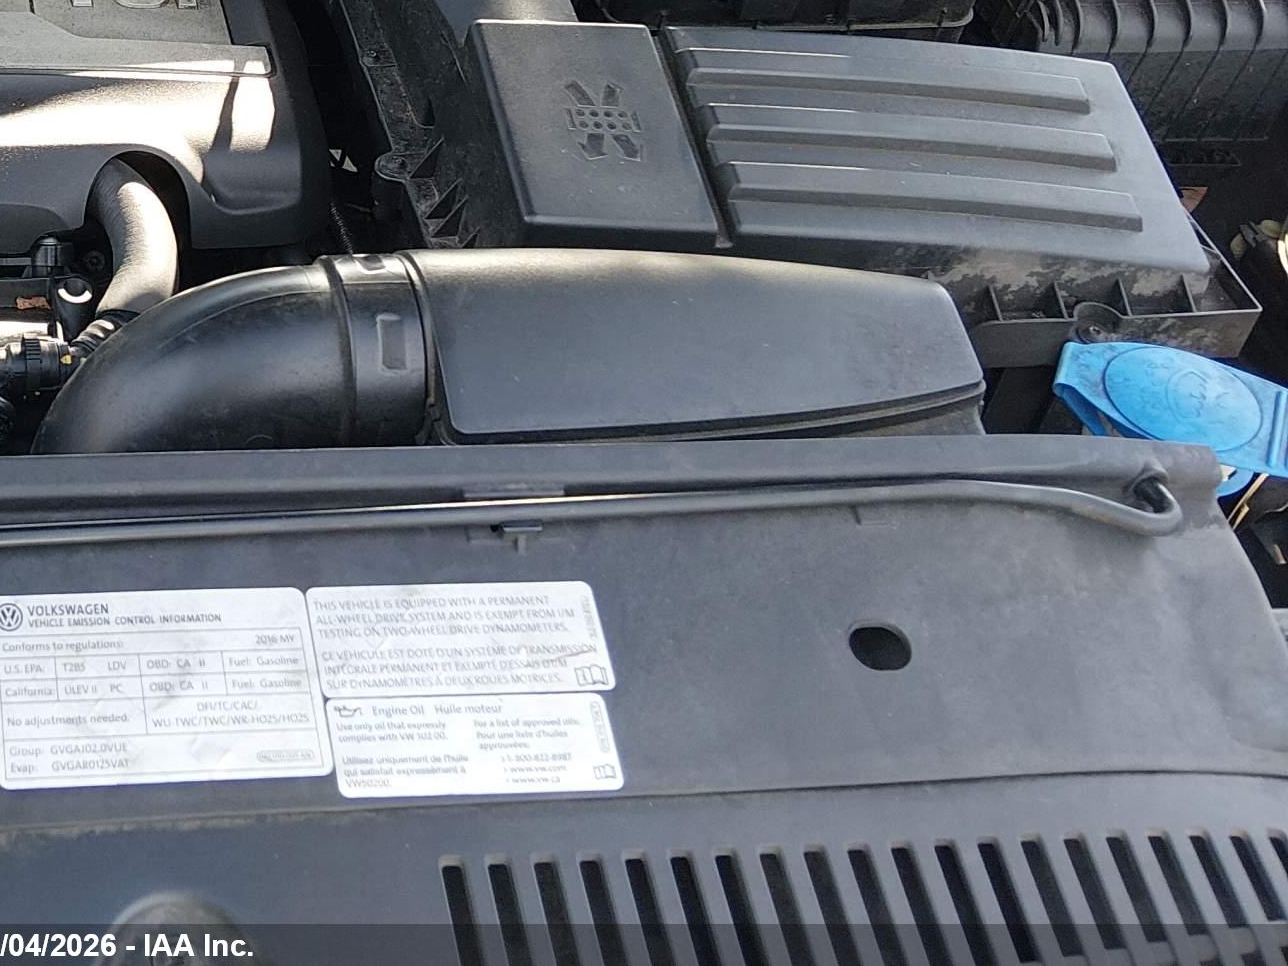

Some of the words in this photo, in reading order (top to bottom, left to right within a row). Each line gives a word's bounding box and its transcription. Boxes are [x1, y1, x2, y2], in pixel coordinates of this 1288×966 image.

[27, 602, 109, 617] VOLKSWAGEN
[313, 601, 336, 610] THIS
[338, 600, 380, 610] VEHICLE
[382, 599, 392, 608] IS
[394, 598, 446, 608] EQUIPPED
[447, 597, 475, 606] WITH
[477, 596, 485, 605] A
[487, 594, 549, 605] PERMANENT
[28, 618, 64, 628] VEHICLE
[67, 616, 110, 627] EMISSION
[114, 614, 155, 625] CONTROL
[158, 612, 221, 623] INFORMATION
[408, 611, 446, 621] SYSTEM
[447, 610, 472, 620] AND
[473, 610, 483, 619] IS
[485, 608, 525, 619] EXEMPT
[526, 607, 556, 618] FROM
[318, 628, 361, 638] TESTING
[363, 627, 379, 636] ON
[448, 624, 479, 633] DRIVE
[2, 641, 50, 654] Conforms
[52, 641, 63, 652] to
[65, 638, 123, 651] regulations:
[254, 632, 277, 644] 2016
[278, 631, 295, 643] MY
[107, 661, 127, 671] LDV
[176, 658, 191, 668] CA
[255, 654, 298, 664] Gasoline
[64, 684, 88, 695] ULEV
[109, 683, 123, 693] PC
[178, 680, 194, 690] CA
[259, 675, 302, 687] Gasoline
[371, 705, 407, 718] Engine
[408, 704, 424, 715] Oil
[433, 704, 462, 714] Huile
[462, 703, 502, 713] moteur
[6, 717, 22, 727] No
[24, 714, 87, 728] adjustments
[89, 712, 130, 724] needed.
